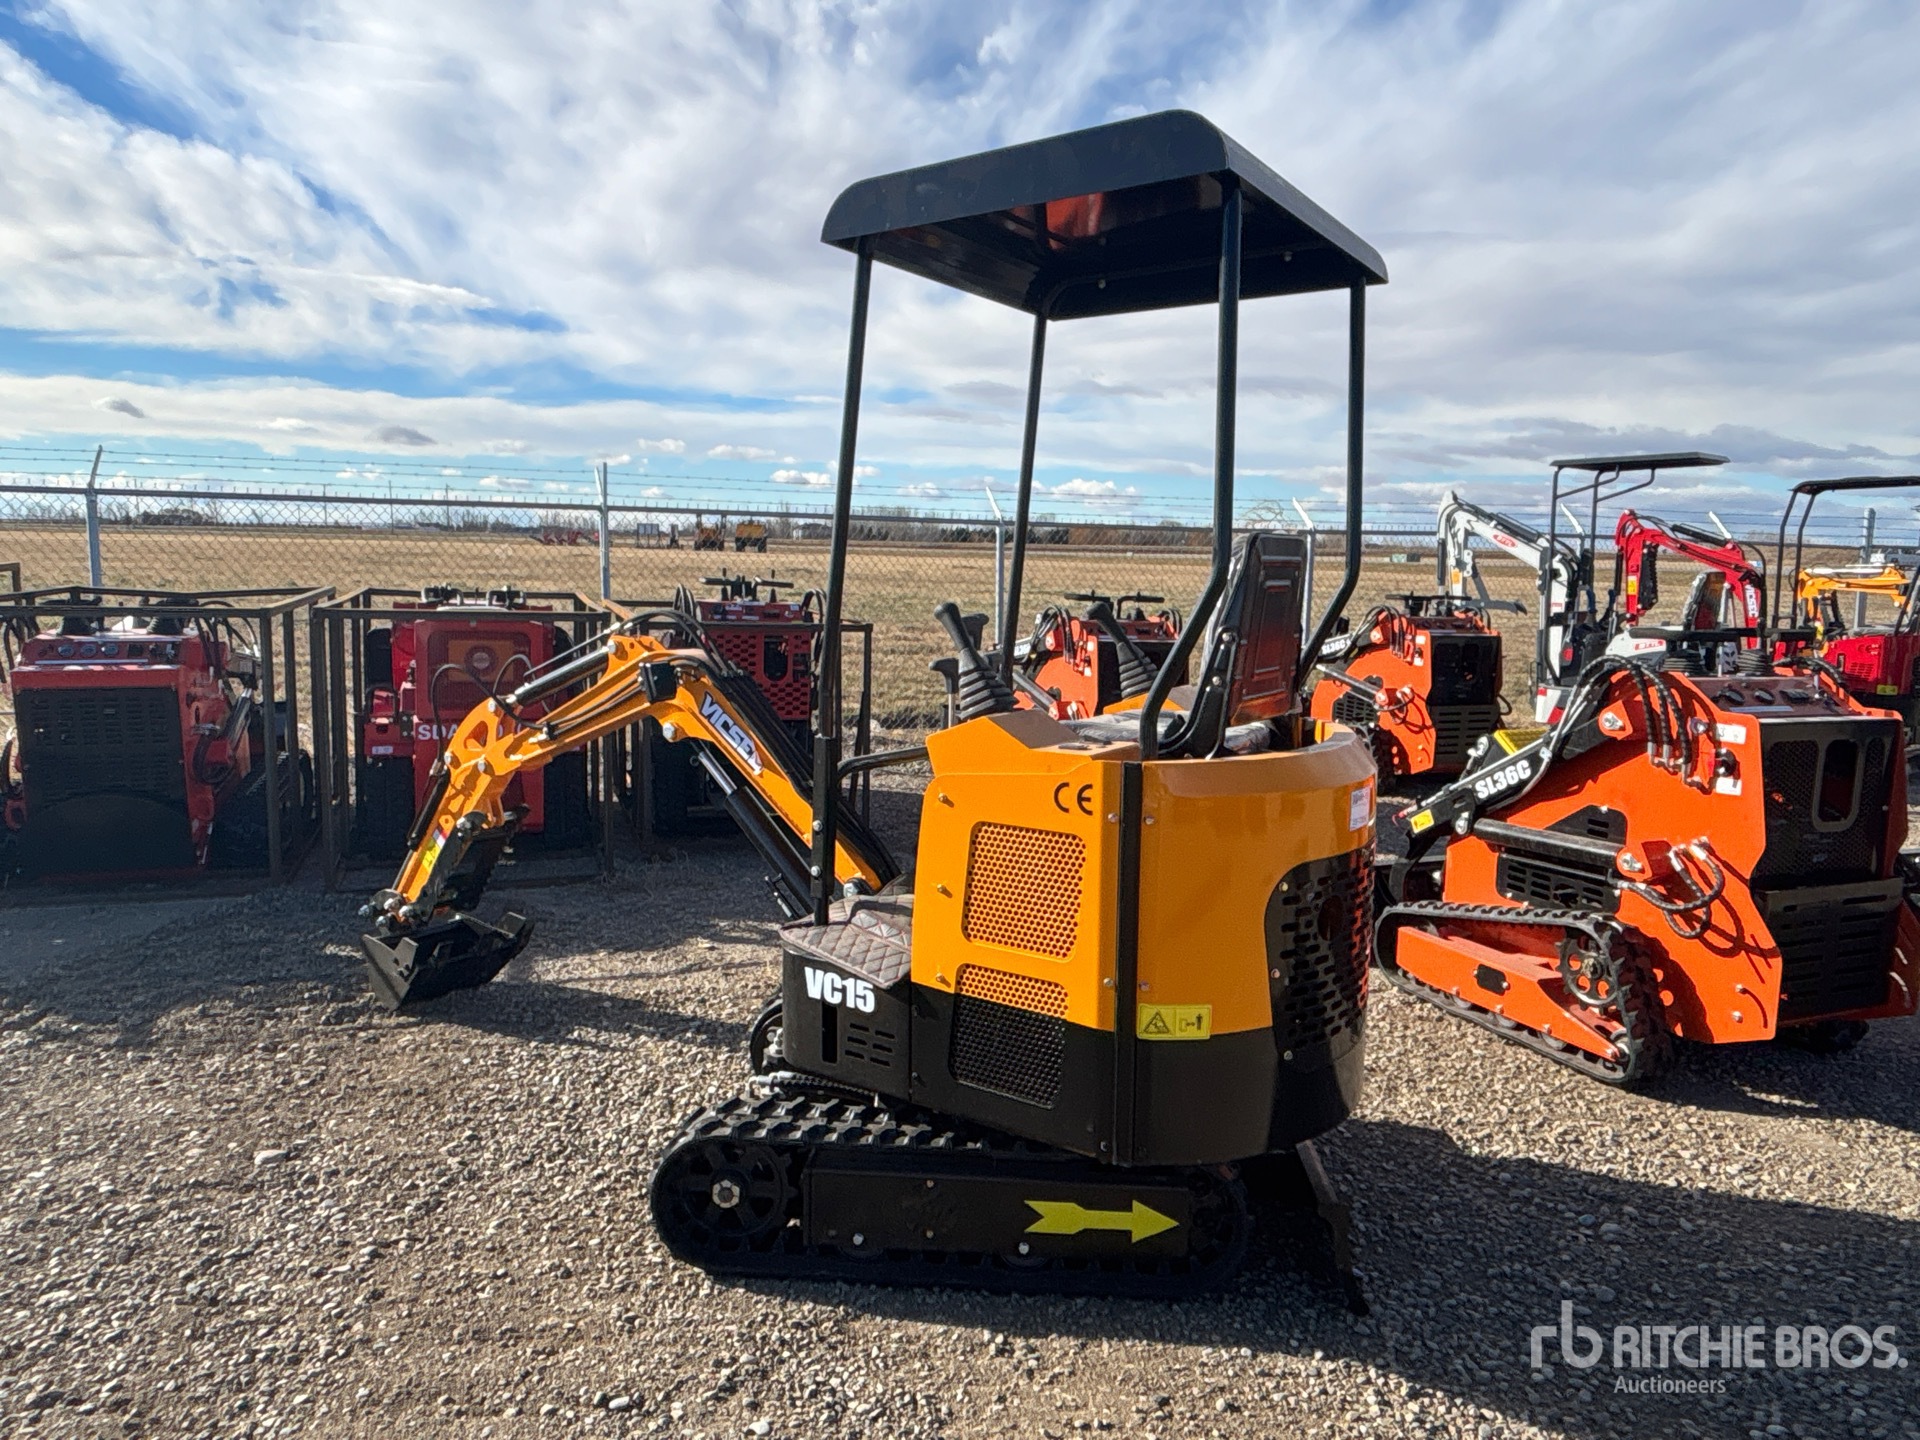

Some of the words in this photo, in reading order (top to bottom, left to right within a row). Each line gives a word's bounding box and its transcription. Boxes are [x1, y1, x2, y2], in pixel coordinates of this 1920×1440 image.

[1054, 782, 1094, 815] CE
[1475, 759, 1531, 799] SL36C
[804, 966, 876, 1013] VC15
